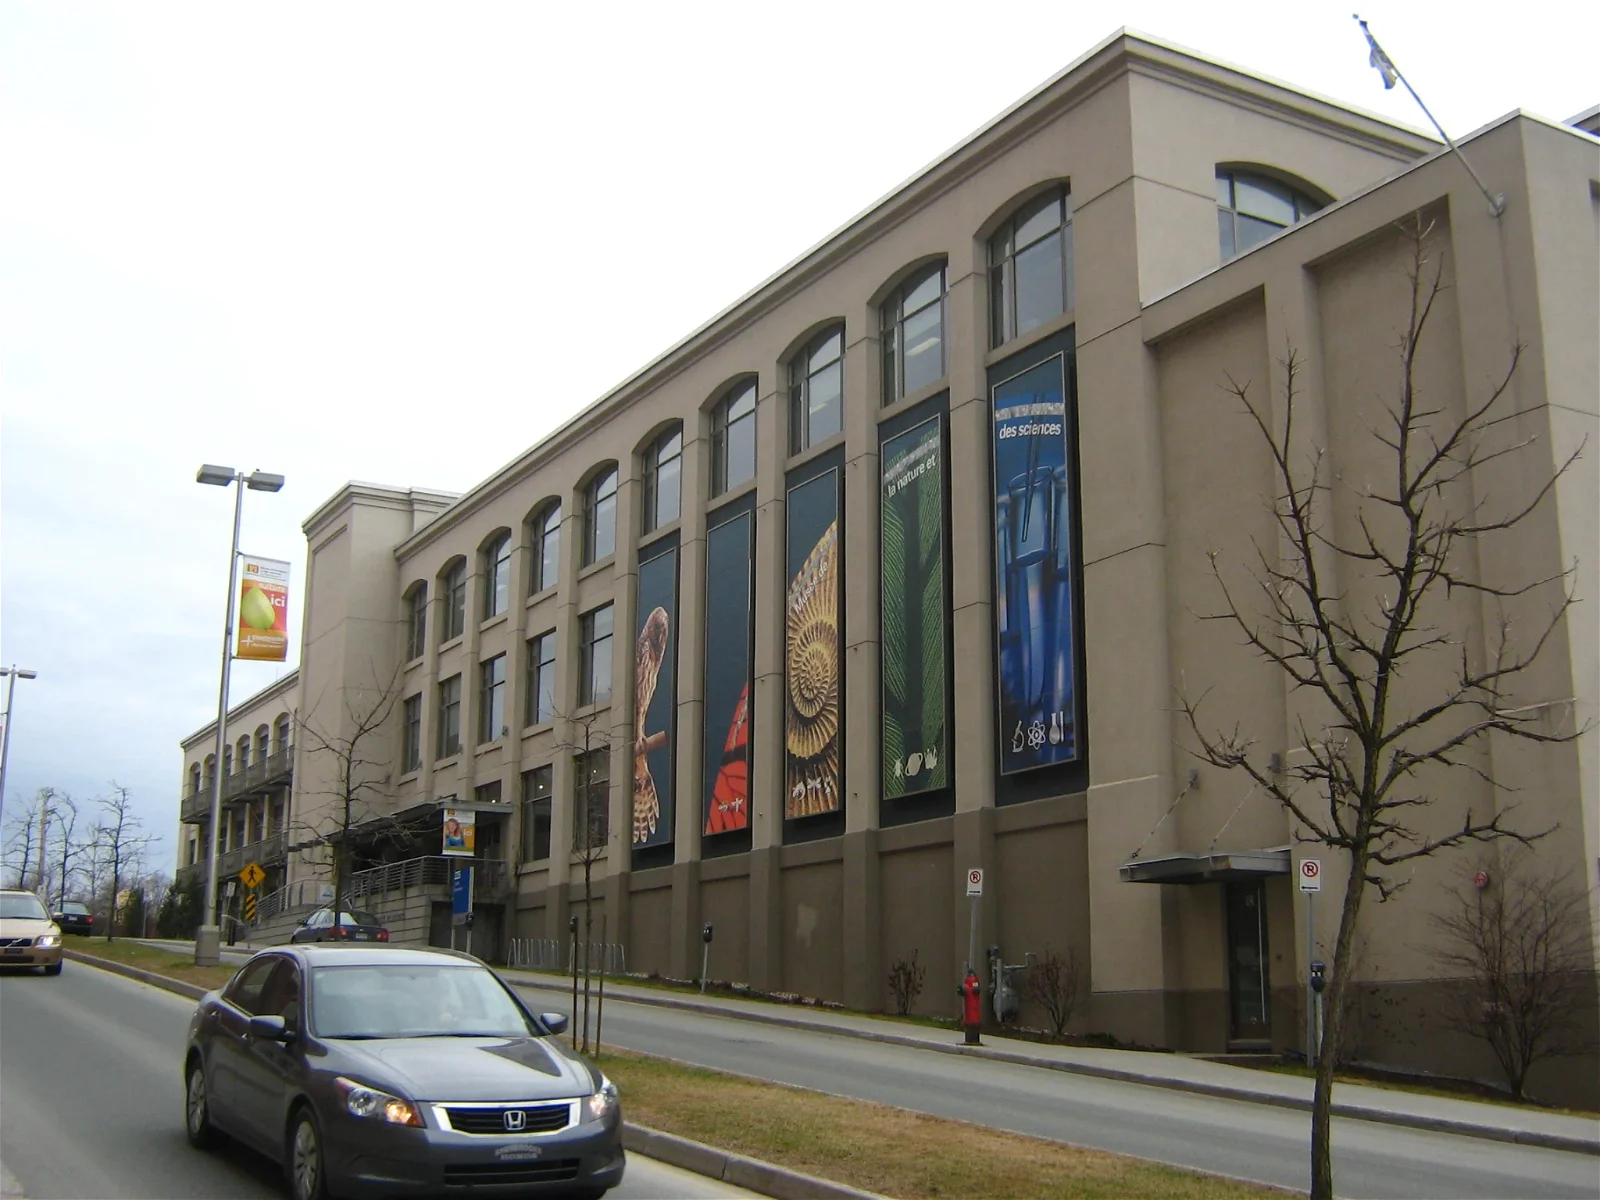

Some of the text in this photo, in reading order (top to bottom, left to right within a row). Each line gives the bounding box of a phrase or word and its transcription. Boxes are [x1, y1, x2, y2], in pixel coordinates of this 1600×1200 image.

[999, 420, 1062, 440] des sciences
[887, 454, 937, 498] la nature et
[270, 594, 286, 608] ici
